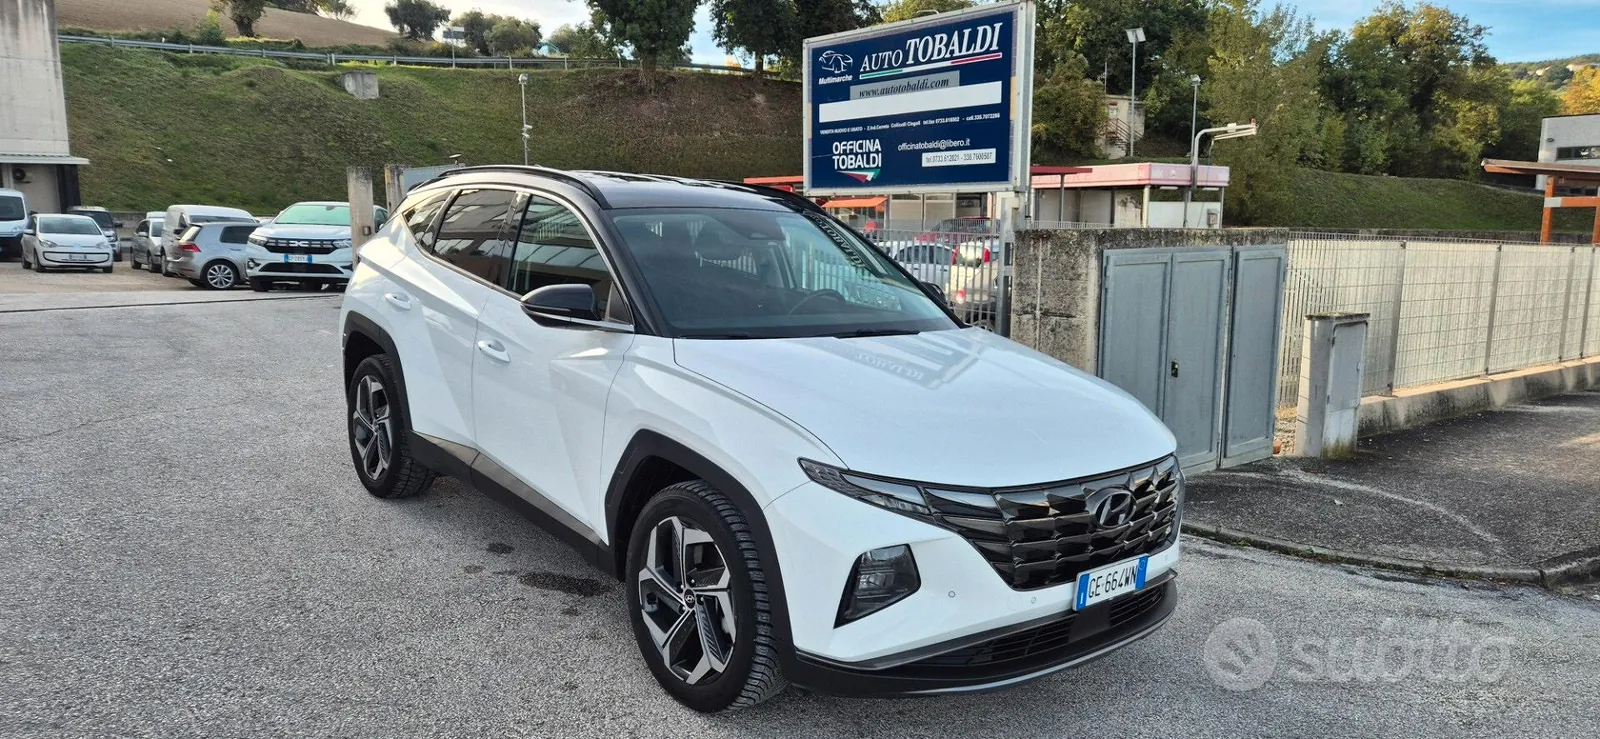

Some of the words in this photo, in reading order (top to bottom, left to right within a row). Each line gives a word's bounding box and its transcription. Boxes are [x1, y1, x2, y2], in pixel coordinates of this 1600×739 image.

[860, 49, 903, 72] AUTO
[906, 22, 1003, 65] TOBALDI
[818, 74, 853, 84] Multimarche
[859, 78, 949, 98] www.autotobaldi.com
[832, 138, 882, 155] OFFICINA
[898, 137, 970, 151] officinatobaldi@libero.it
[832, 152, 882, 170] TOBALDI
